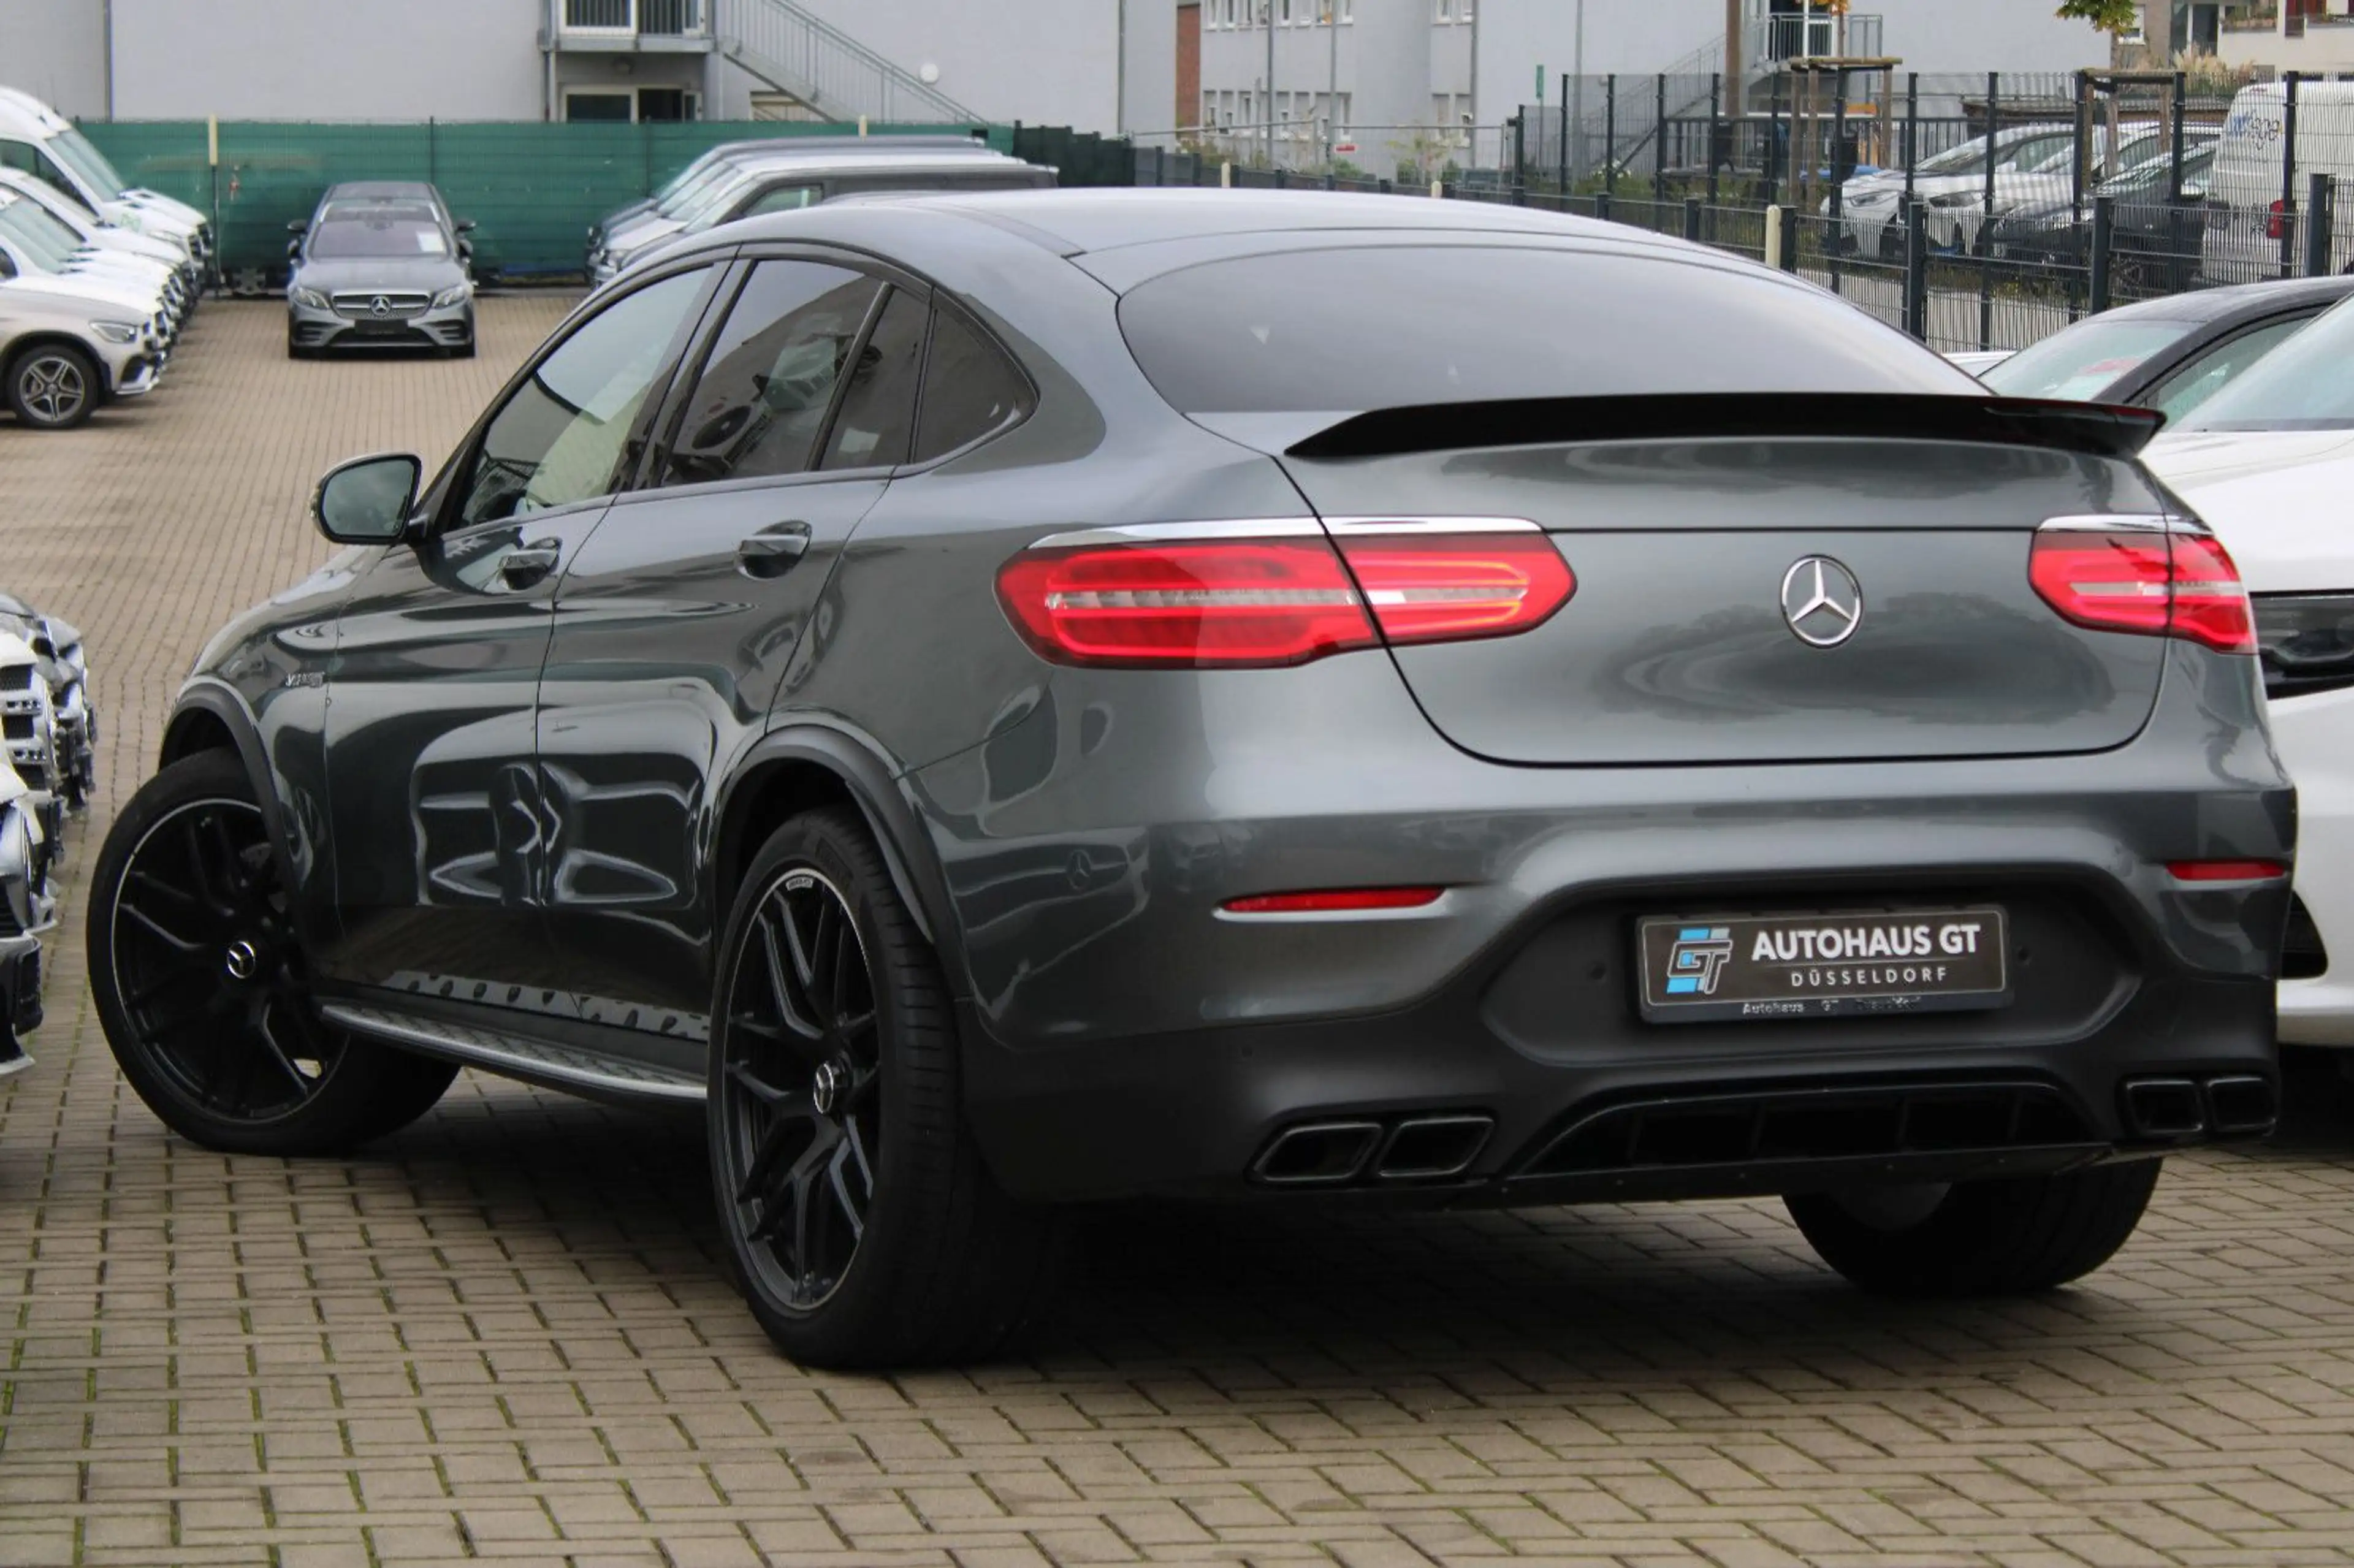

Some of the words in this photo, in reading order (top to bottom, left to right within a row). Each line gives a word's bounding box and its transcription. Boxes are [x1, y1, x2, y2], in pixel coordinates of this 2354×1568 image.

[1751, 924, 1932, 962] AUTOHAUS
[1938, 923, 1981, 954] GT
[1791, 965, 1948, 987] DÜSSELDORF
